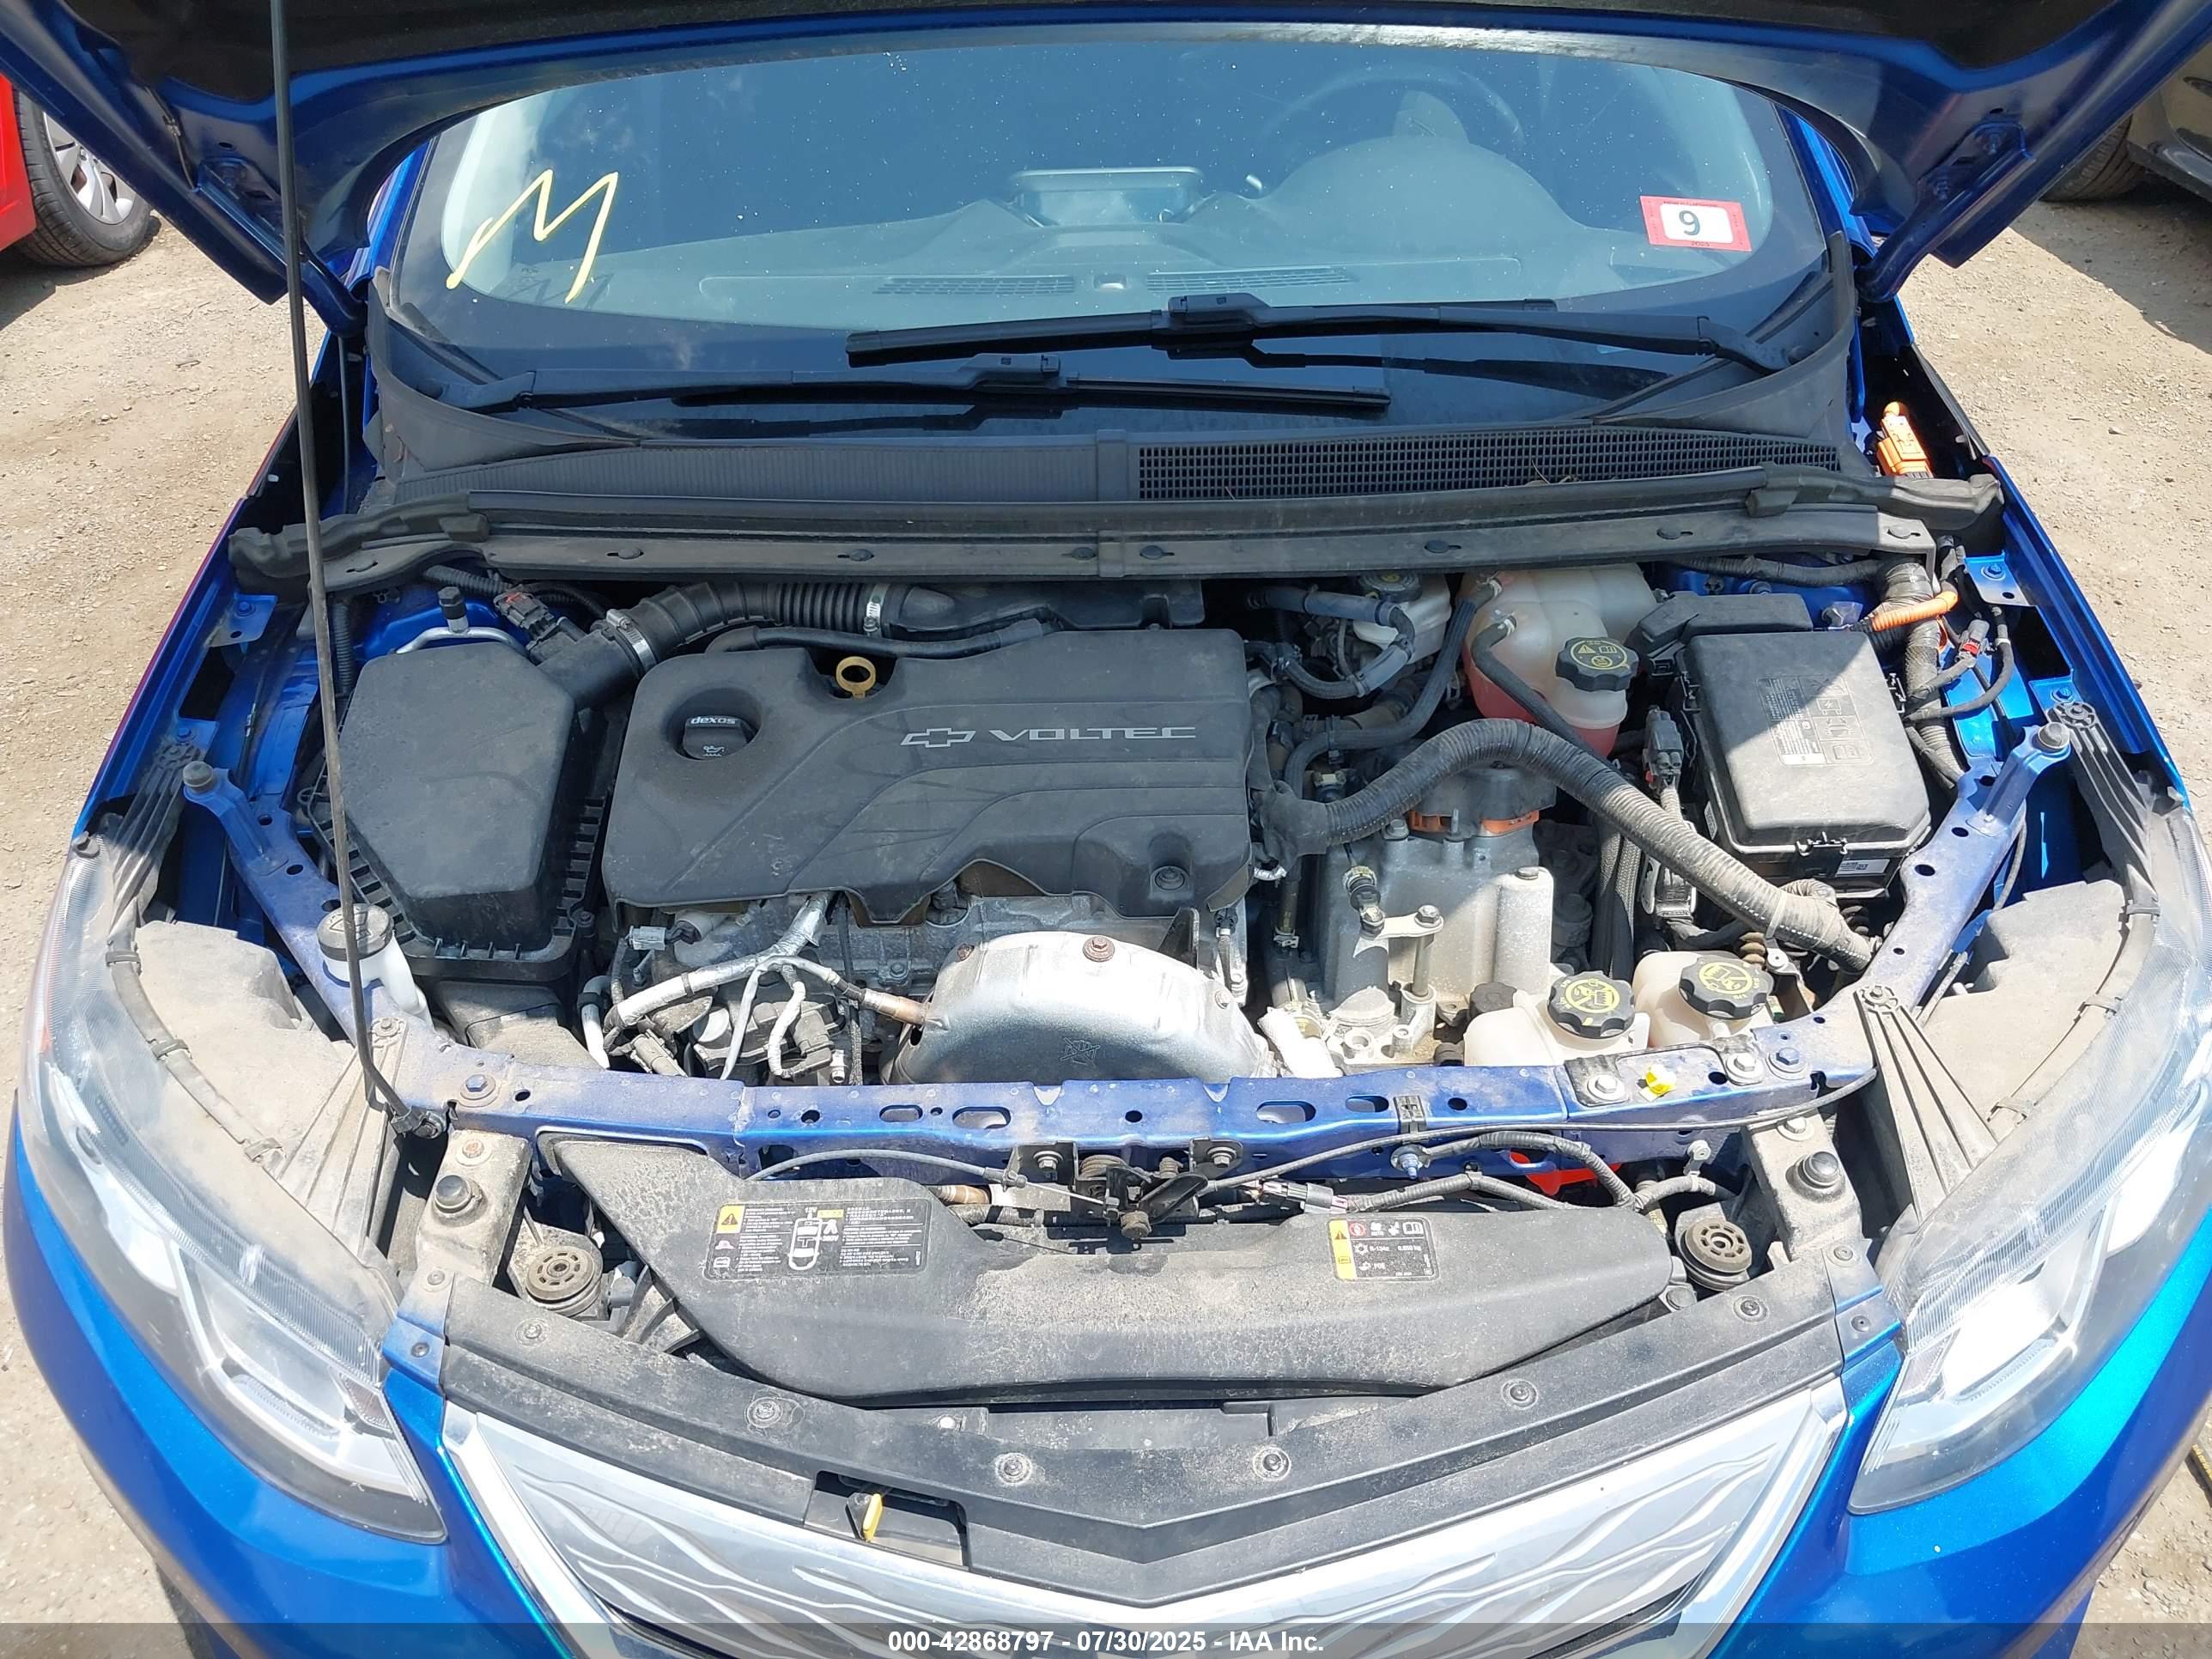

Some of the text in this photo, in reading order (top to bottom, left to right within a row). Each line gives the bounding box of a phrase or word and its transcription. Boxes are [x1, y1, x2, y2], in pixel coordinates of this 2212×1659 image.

[1678, 210, 1701, 236] 9
[690, 716, 737, 725] dexos
[988, 726, 1196, 742] VOLTEC
